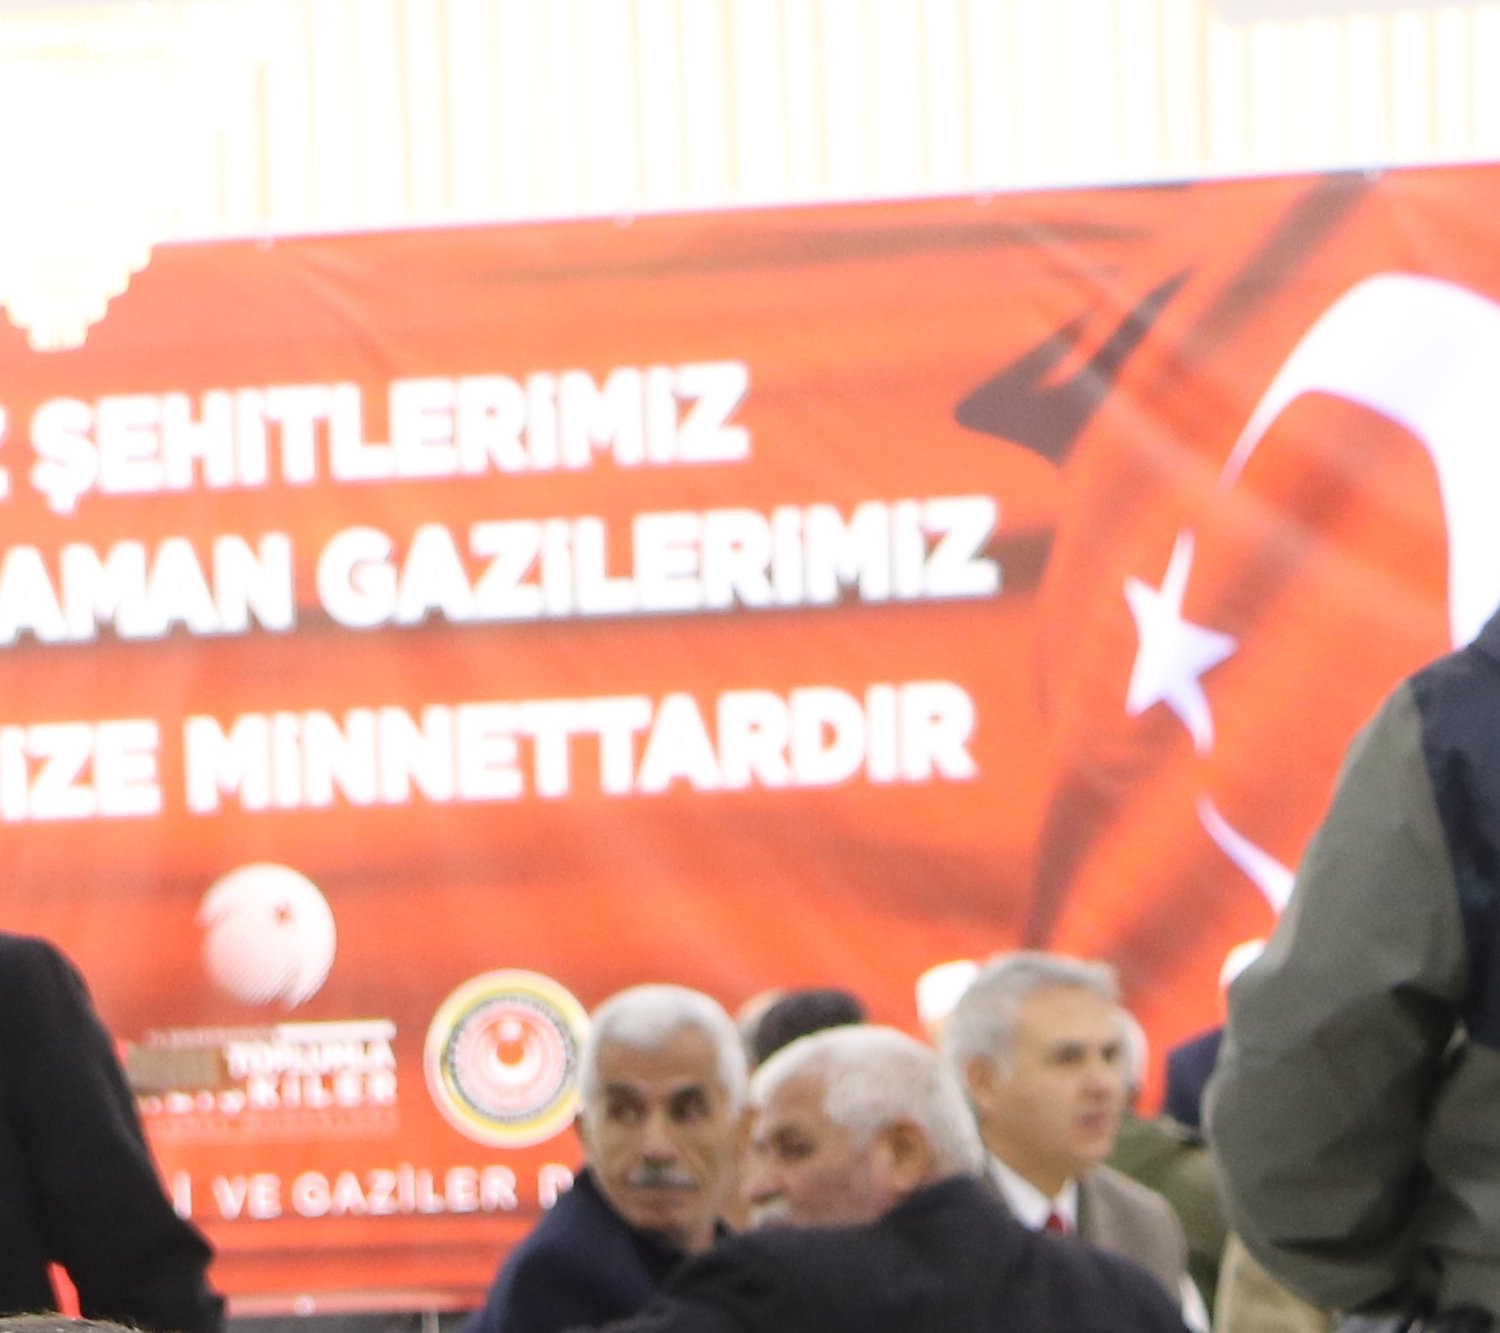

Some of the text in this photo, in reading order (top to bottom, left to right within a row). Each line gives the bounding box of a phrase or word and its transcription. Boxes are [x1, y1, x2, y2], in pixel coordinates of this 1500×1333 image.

[183, 680, 979, 815] MİNNETTARDIR
[211, 1171, 283, 1221] VE
[291, 1160, 519, 1218] GAZİLER
